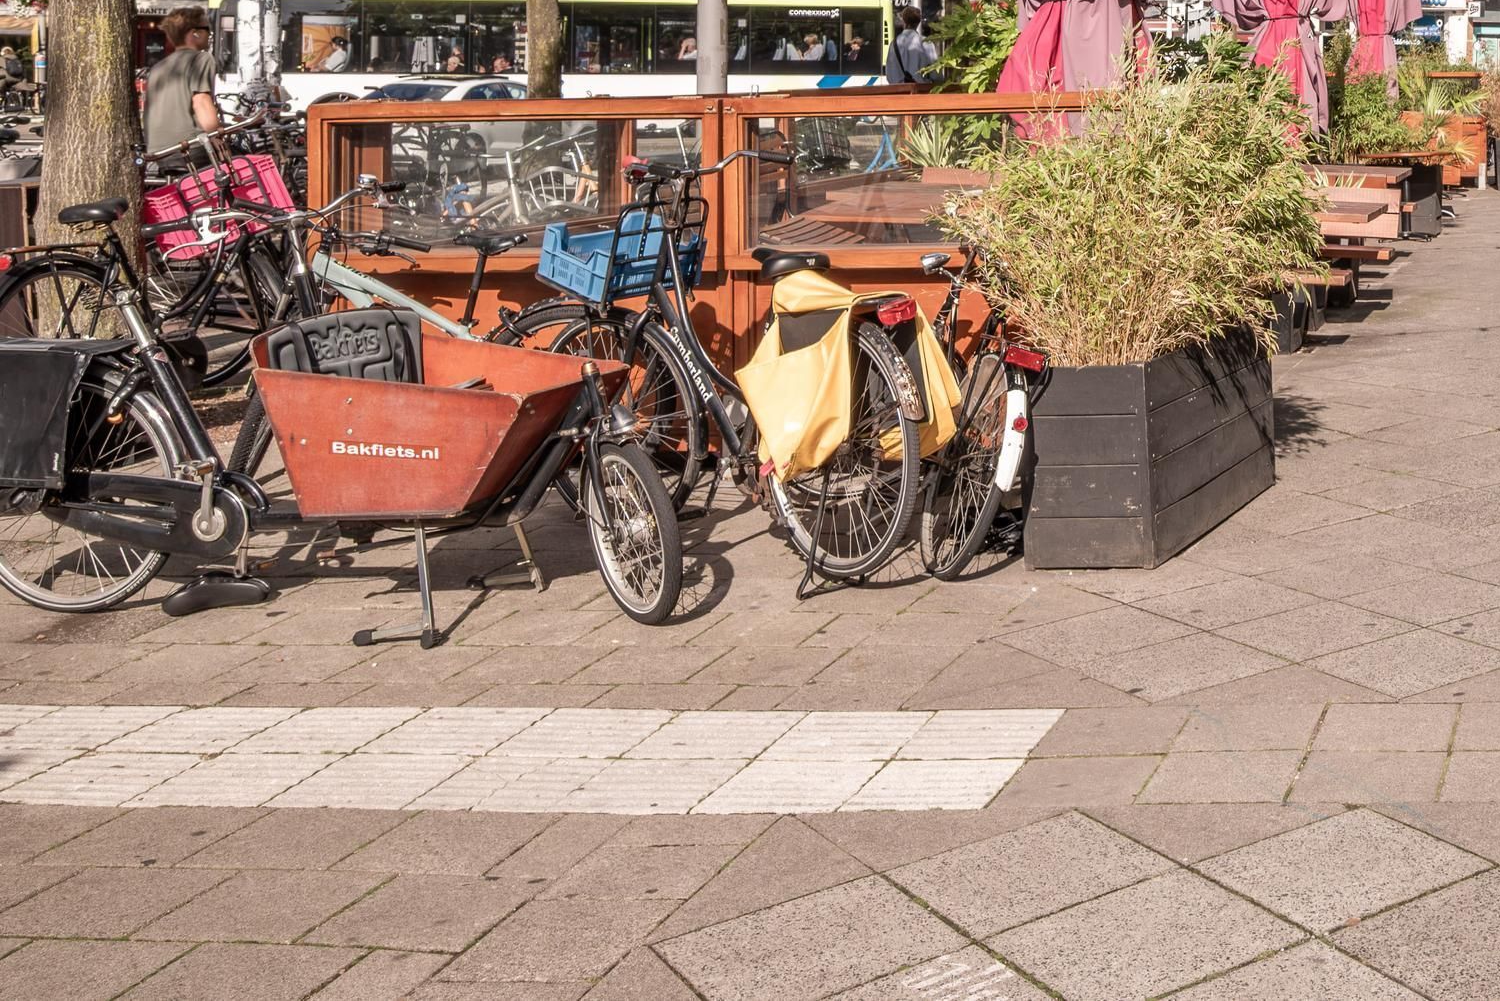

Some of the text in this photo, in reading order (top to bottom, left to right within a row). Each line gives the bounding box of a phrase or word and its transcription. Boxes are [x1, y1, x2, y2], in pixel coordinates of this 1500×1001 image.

[137, 7, 168, 15] RANTE
[788, 8, 831, 16] connexxion
[308, 325, 382, 360] Bakfiets
[670, 326, 714, 403] Cumberland
[331, 441, 439, 460] Bakfiets.nl
